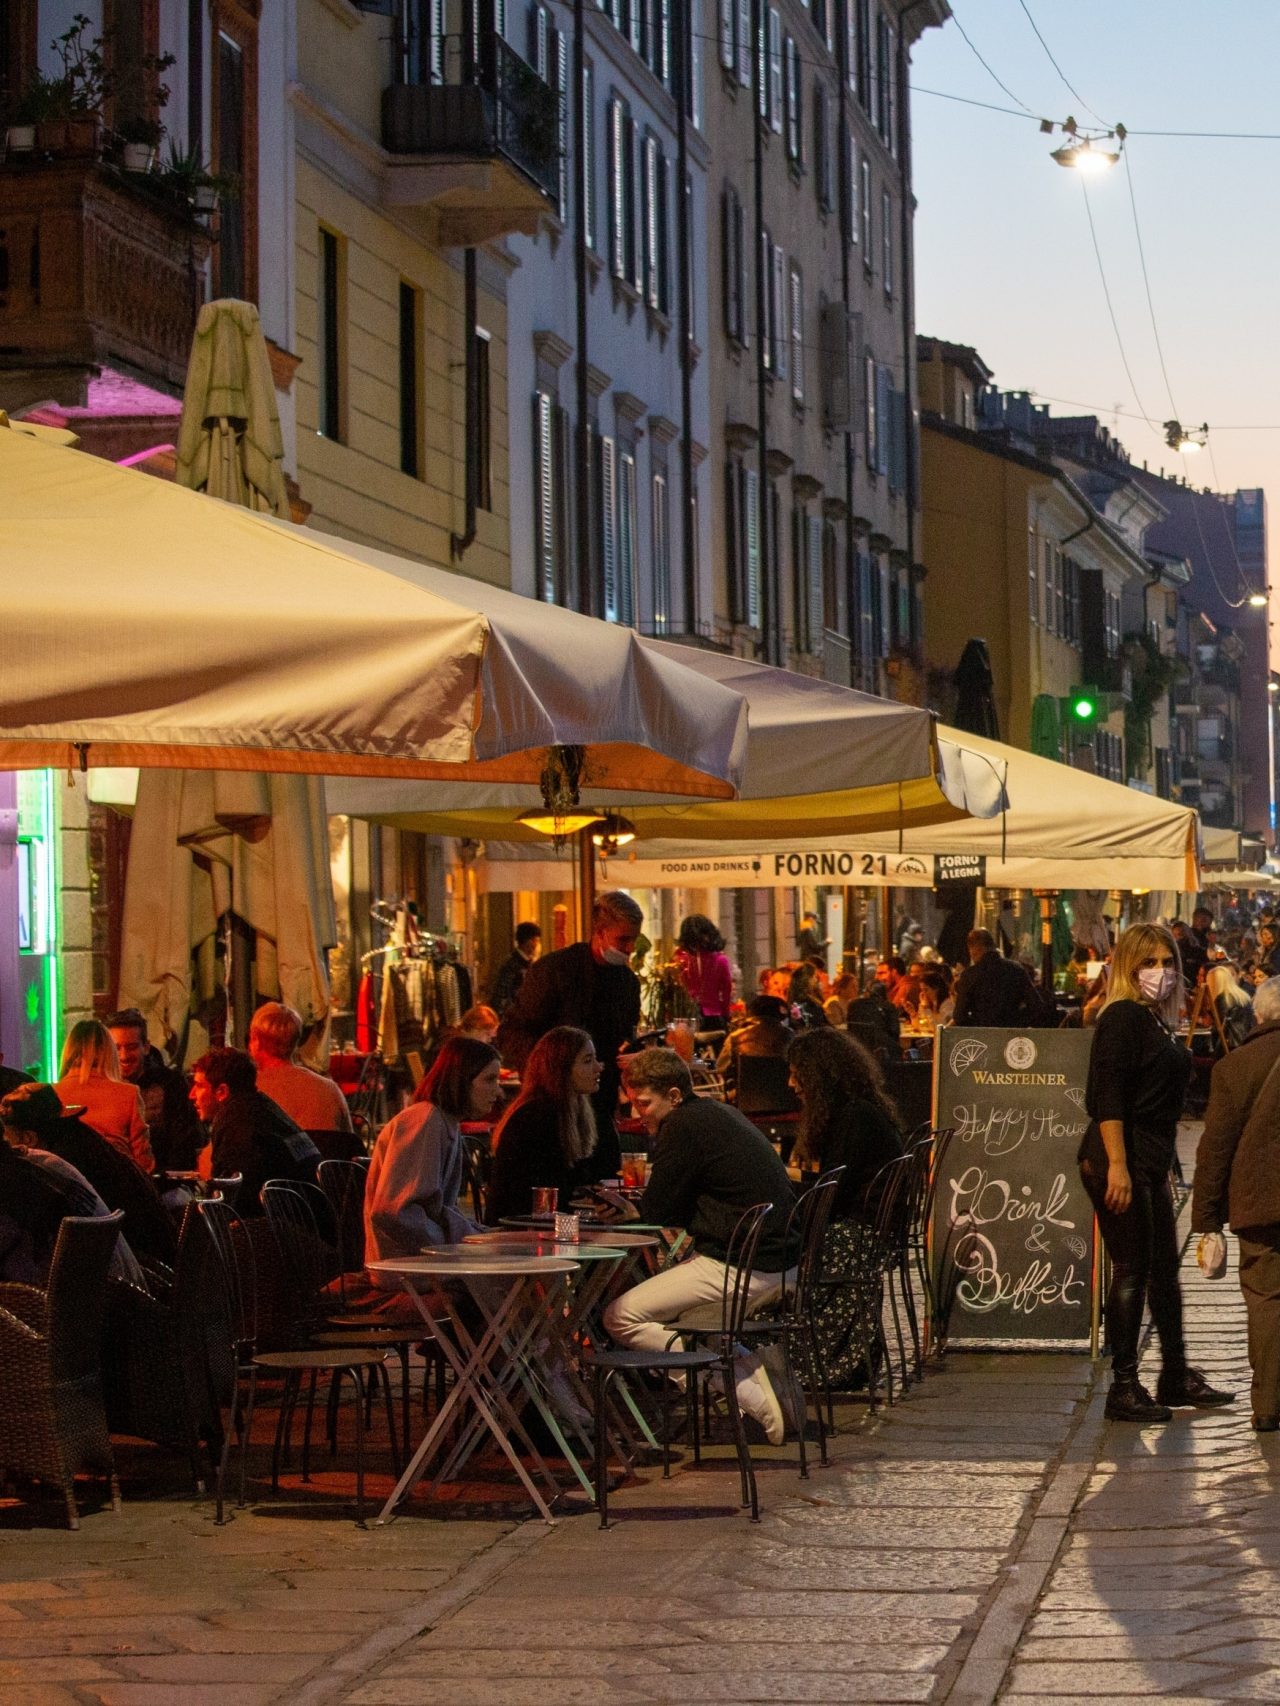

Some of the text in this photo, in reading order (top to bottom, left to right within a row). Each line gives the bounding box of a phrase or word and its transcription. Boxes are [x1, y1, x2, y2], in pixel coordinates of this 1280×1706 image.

[661, 861, 750, 873] FOOD AND DRINKS
[774, 853, 853, 877] FORNO
[861, 853, 887, 876] 21
[939, 855, 980, 869] FORNO
[941, 867, 981, 880] A LEGNA
[972, 1071, 1067, 1086] WARSTEINER
[952, 1103, 1029, 1156] Happy
[1024, 1222, 1051, 1253] &
